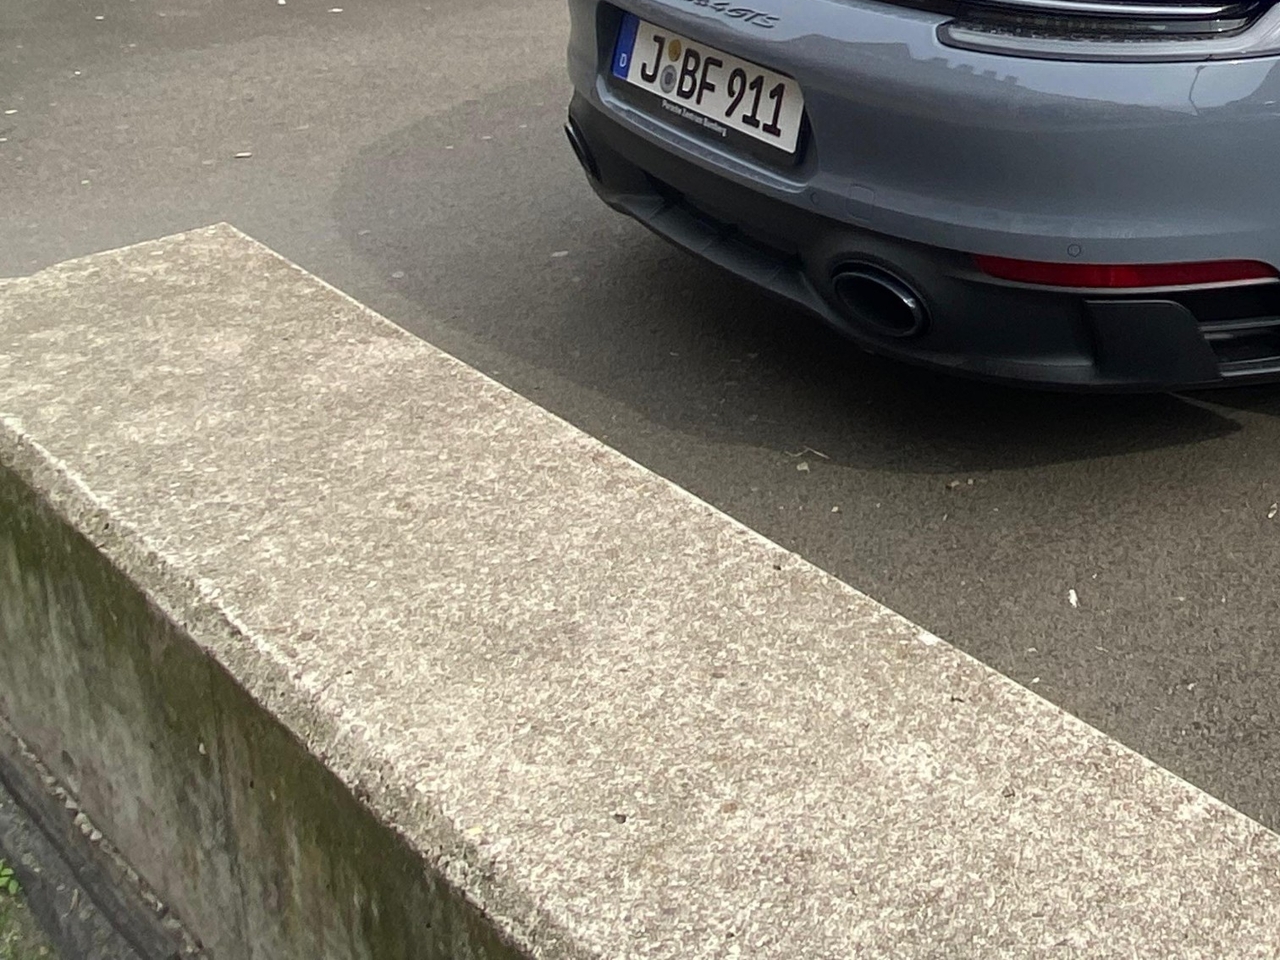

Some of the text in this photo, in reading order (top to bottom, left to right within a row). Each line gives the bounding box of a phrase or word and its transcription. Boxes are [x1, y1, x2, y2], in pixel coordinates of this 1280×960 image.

[619, 53, 627, 68] D
[640, 34, 786, 138] J BF 911
